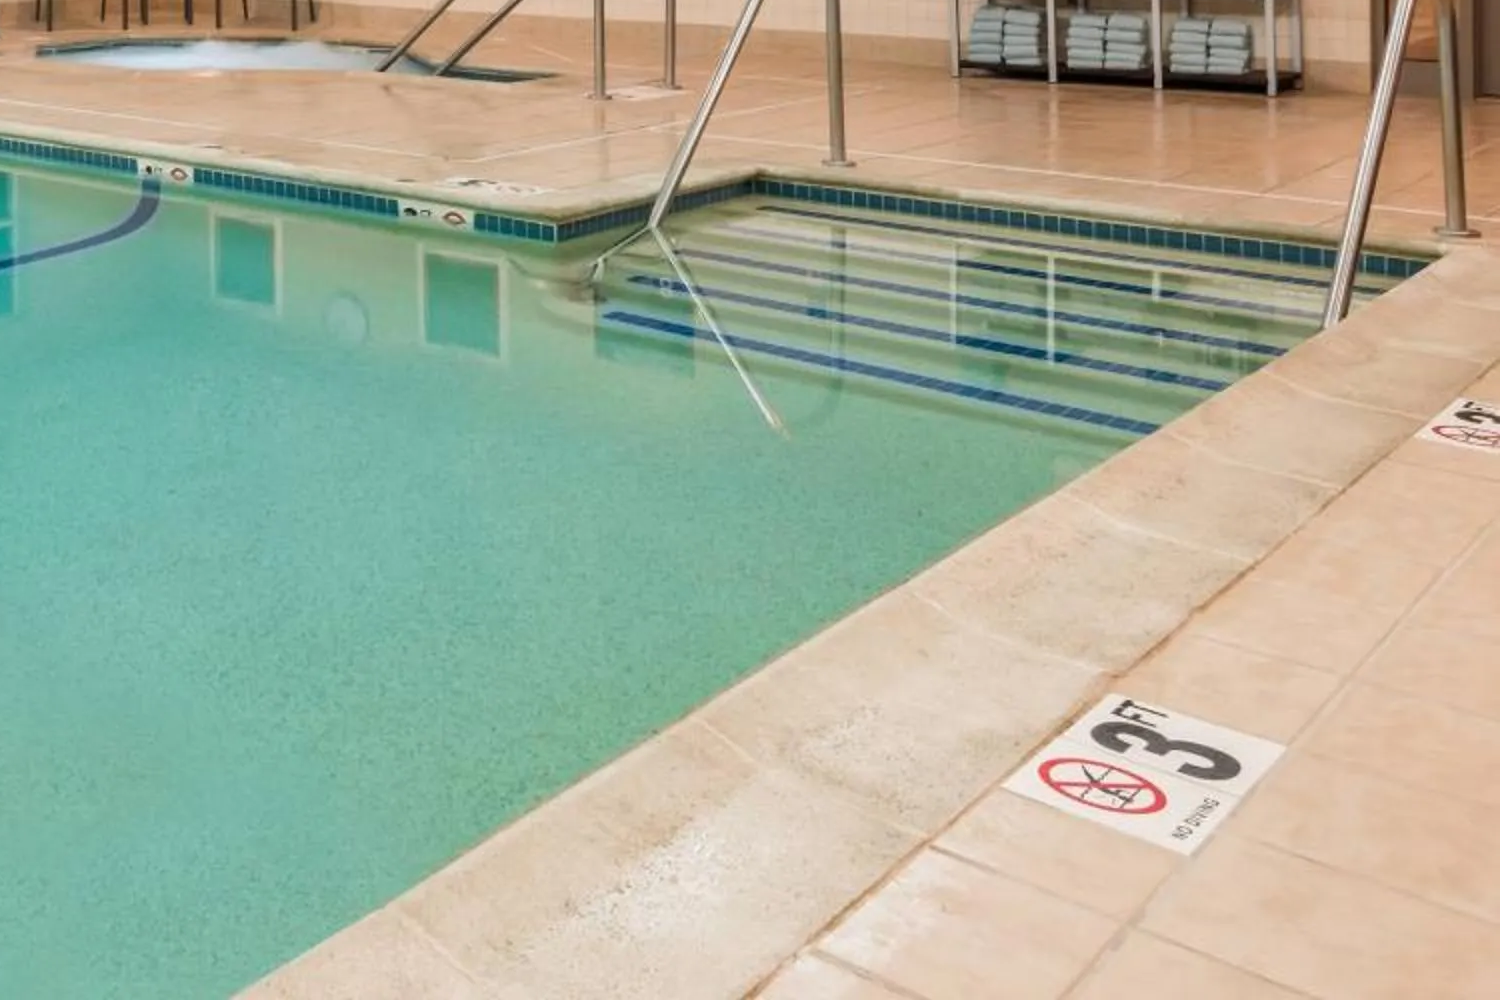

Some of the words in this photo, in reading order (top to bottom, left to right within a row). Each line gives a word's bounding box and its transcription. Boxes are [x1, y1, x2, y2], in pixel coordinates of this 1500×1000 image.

[1110, 698, 1171, 729] FT
[1090, 720, 1242, 781] 3
[1171, 820, 1194, 841] NO
[1186, 797, 1222, 828] DIVING
